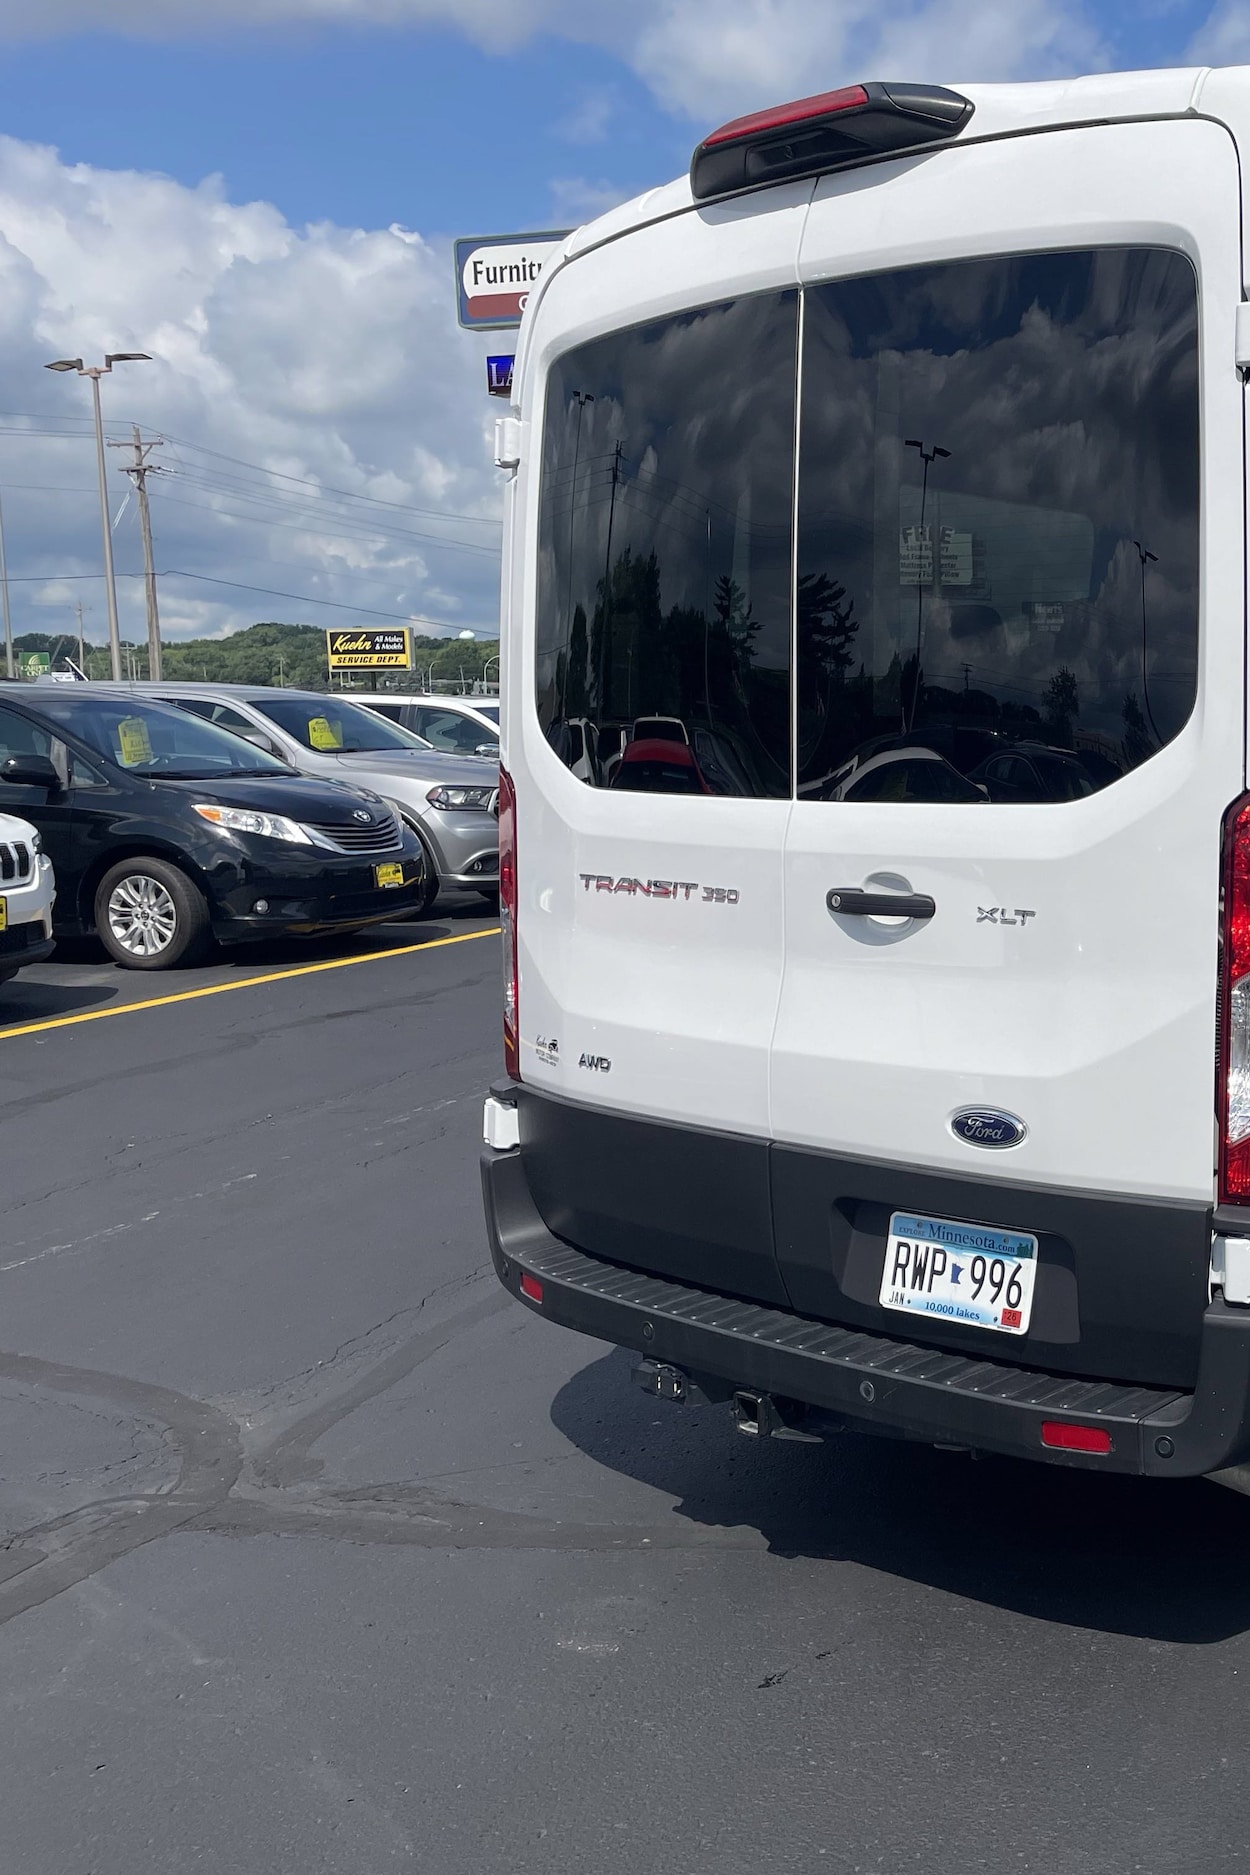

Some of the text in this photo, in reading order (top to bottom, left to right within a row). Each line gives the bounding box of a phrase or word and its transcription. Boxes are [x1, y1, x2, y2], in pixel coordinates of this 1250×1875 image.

[332, 633, 403, 653] Kuehn All Makes
[337, 655, 401, 664] SERVICE DEPT.
[578, 873, 740, 904] TRANSIT 350
[975, 905, 1036, 926] XLT
[578, 1052, 612, 1073] AWD
[963, 1116, 1006, 1140] Ford
[898, 1226, 926, 1237] EXPLORE
[891, 1241, 1023, 1309] RWP 996
[889, 1290, 905, 1306] JAN
[925, 1301, 980, 1320] 10,000 lakes
